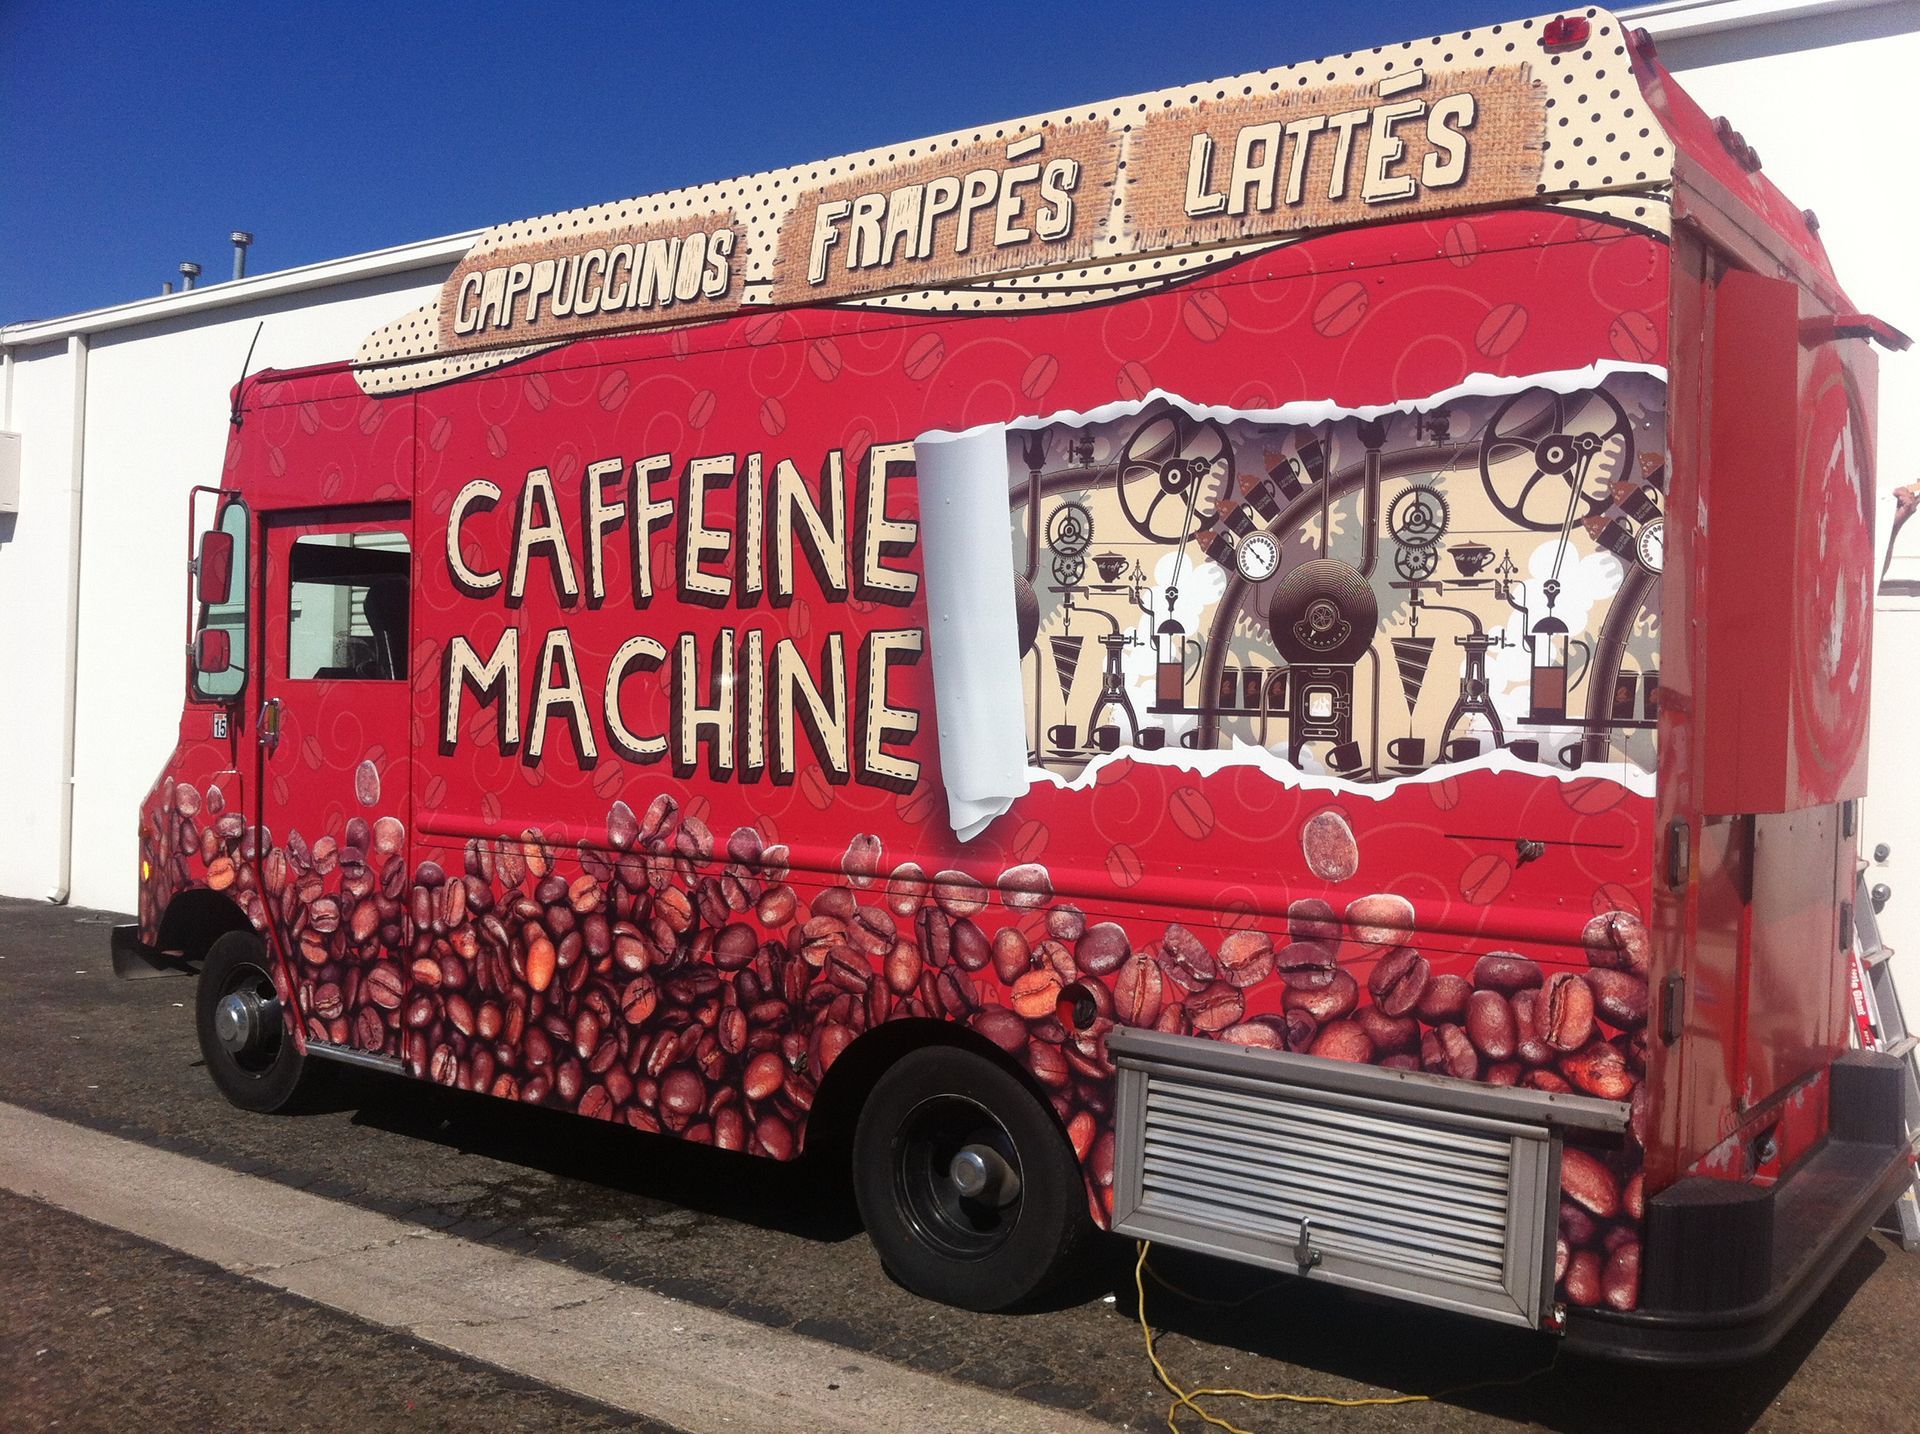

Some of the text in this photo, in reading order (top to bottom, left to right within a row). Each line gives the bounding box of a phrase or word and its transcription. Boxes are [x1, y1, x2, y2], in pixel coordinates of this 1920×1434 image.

[807, 134, 1079, 285] FRAPPÉS
[1184, 69, 1475, 216] LATTÉS
[453, 228, 734, 334] CAPPUCCINOS
[446, 440, 919, 610] CAFFEINE
[215, 720, 226, 736] 15
[440, 626, 924, 796] MACHINE
